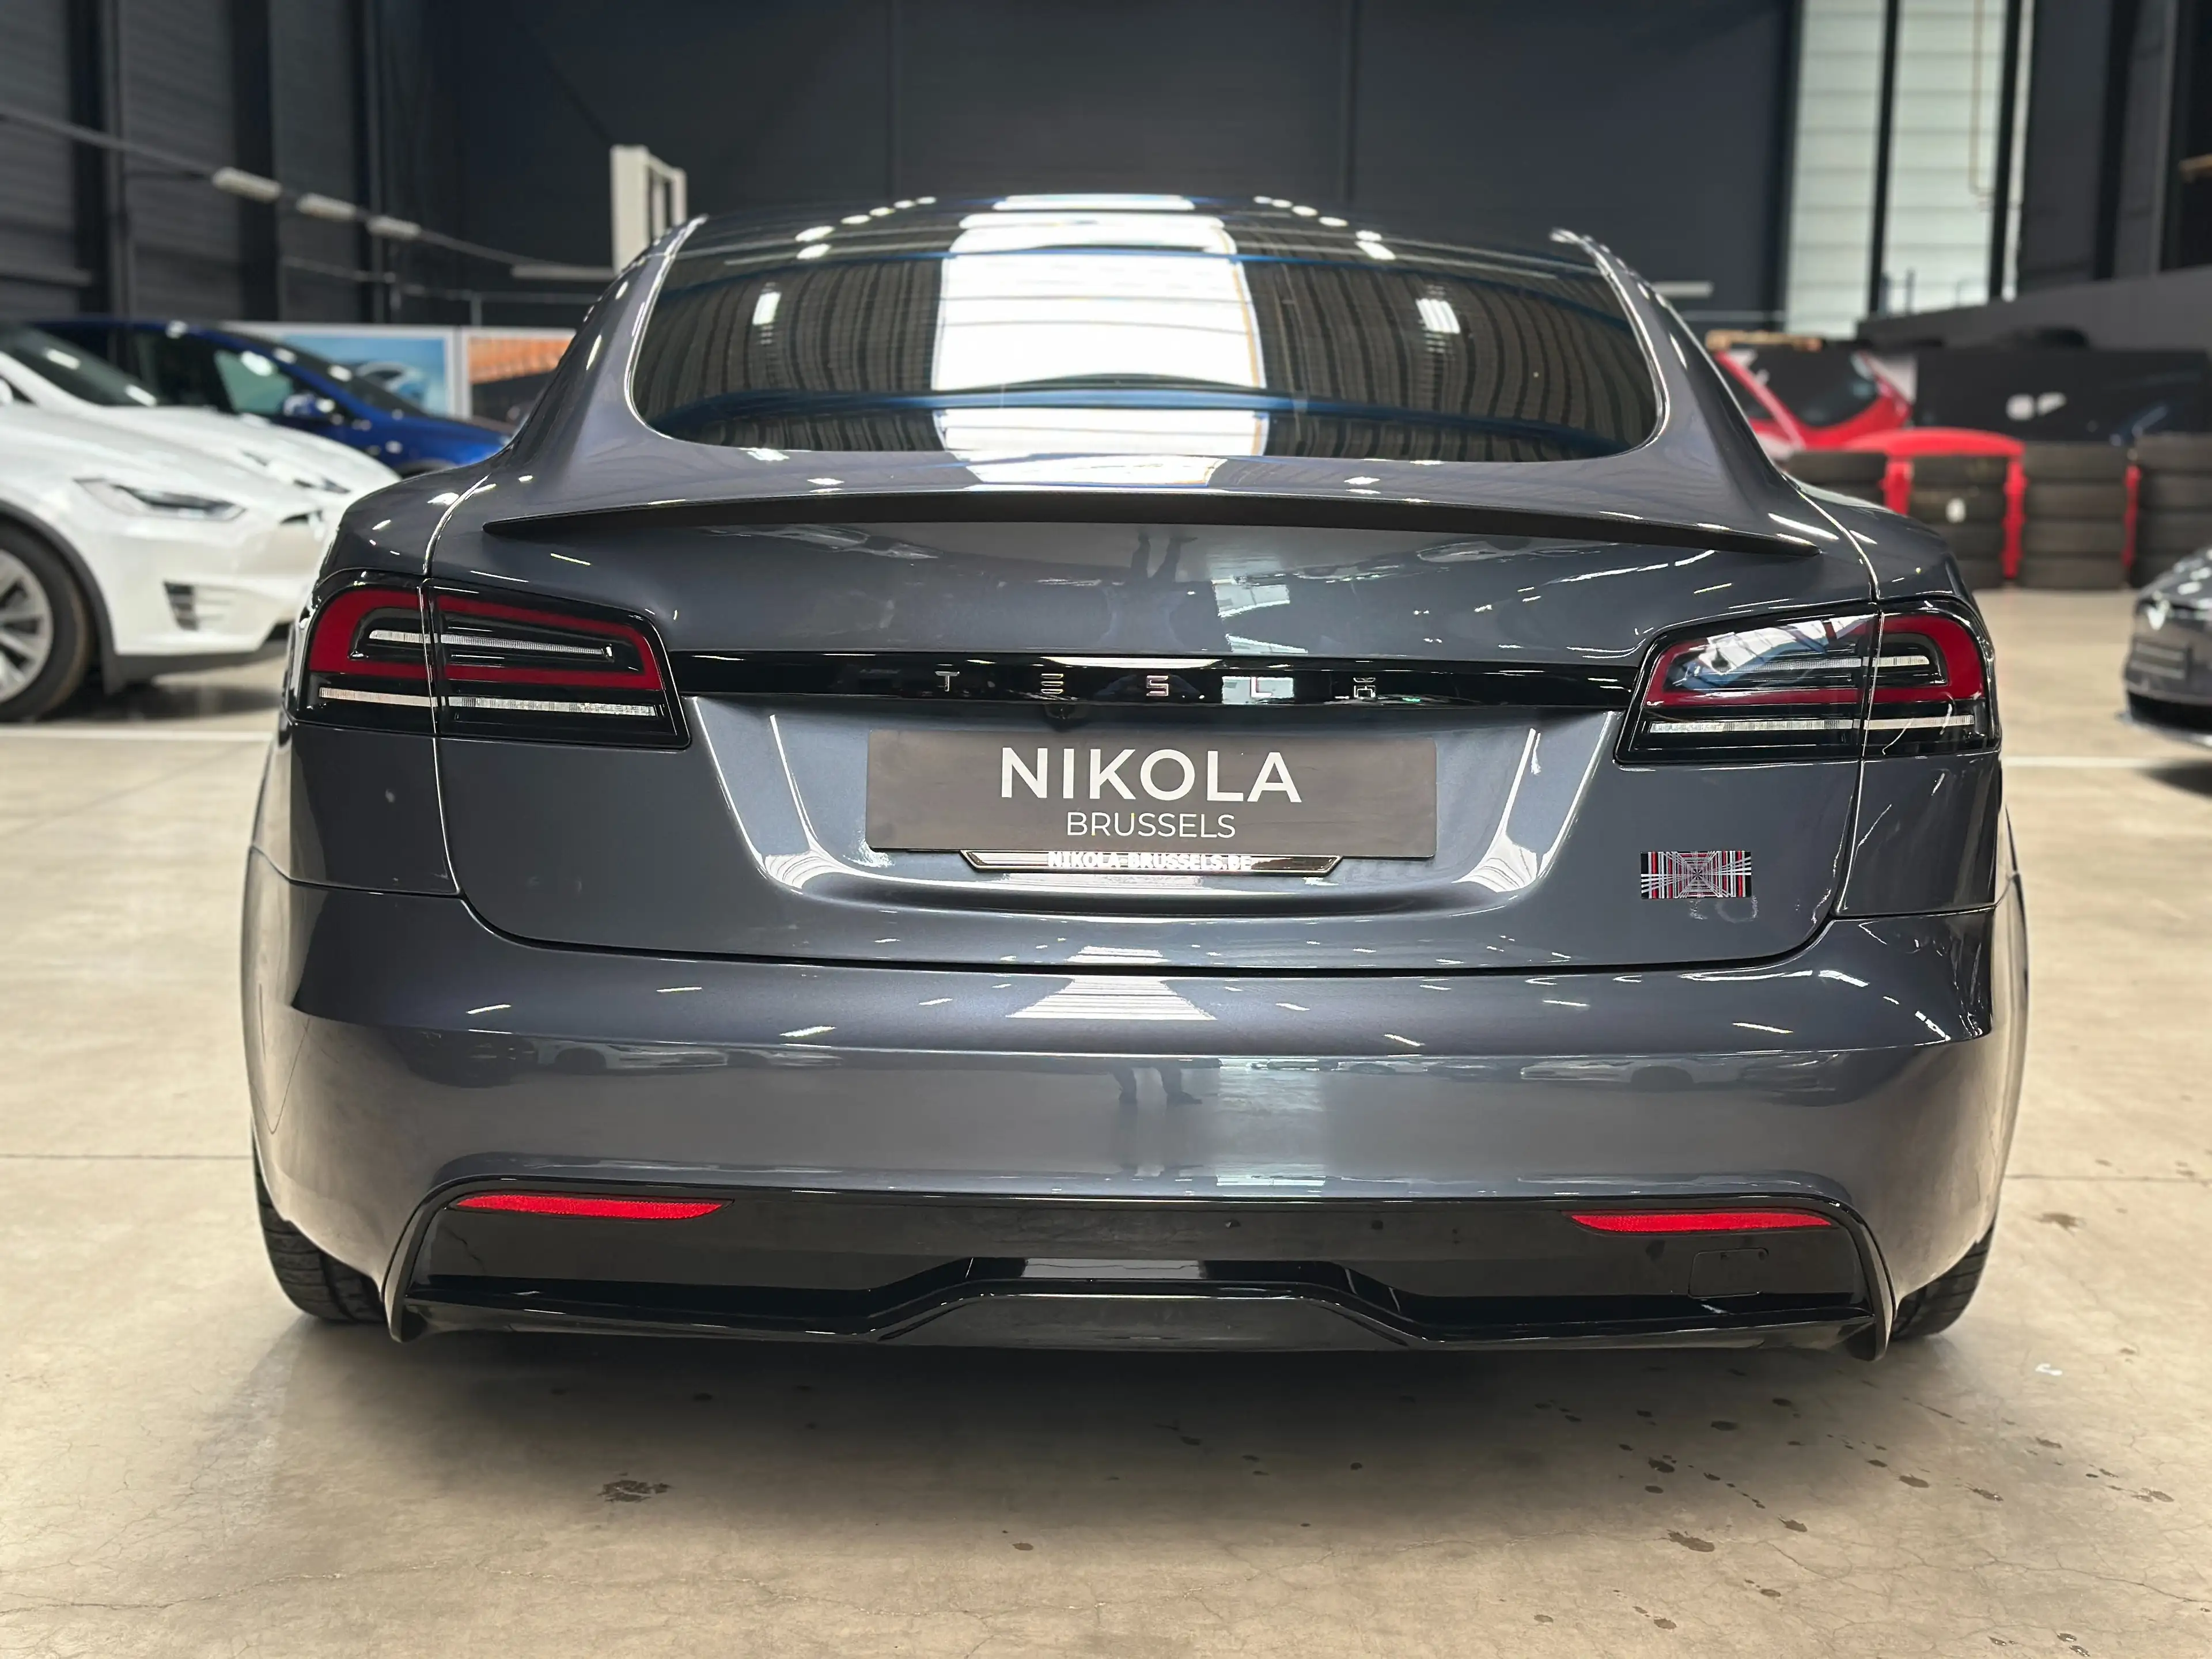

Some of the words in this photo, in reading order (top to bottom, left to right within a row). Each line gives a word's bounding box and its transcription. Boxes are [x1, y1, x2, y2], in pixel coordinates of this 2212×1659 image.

[1001, 747, 1302, 802] NIKOLA
[1067, 812, 1236, 838] BRUSSELS
[1047, 851, 1252, 870] NIKOLA-BRUSSELS.BE
